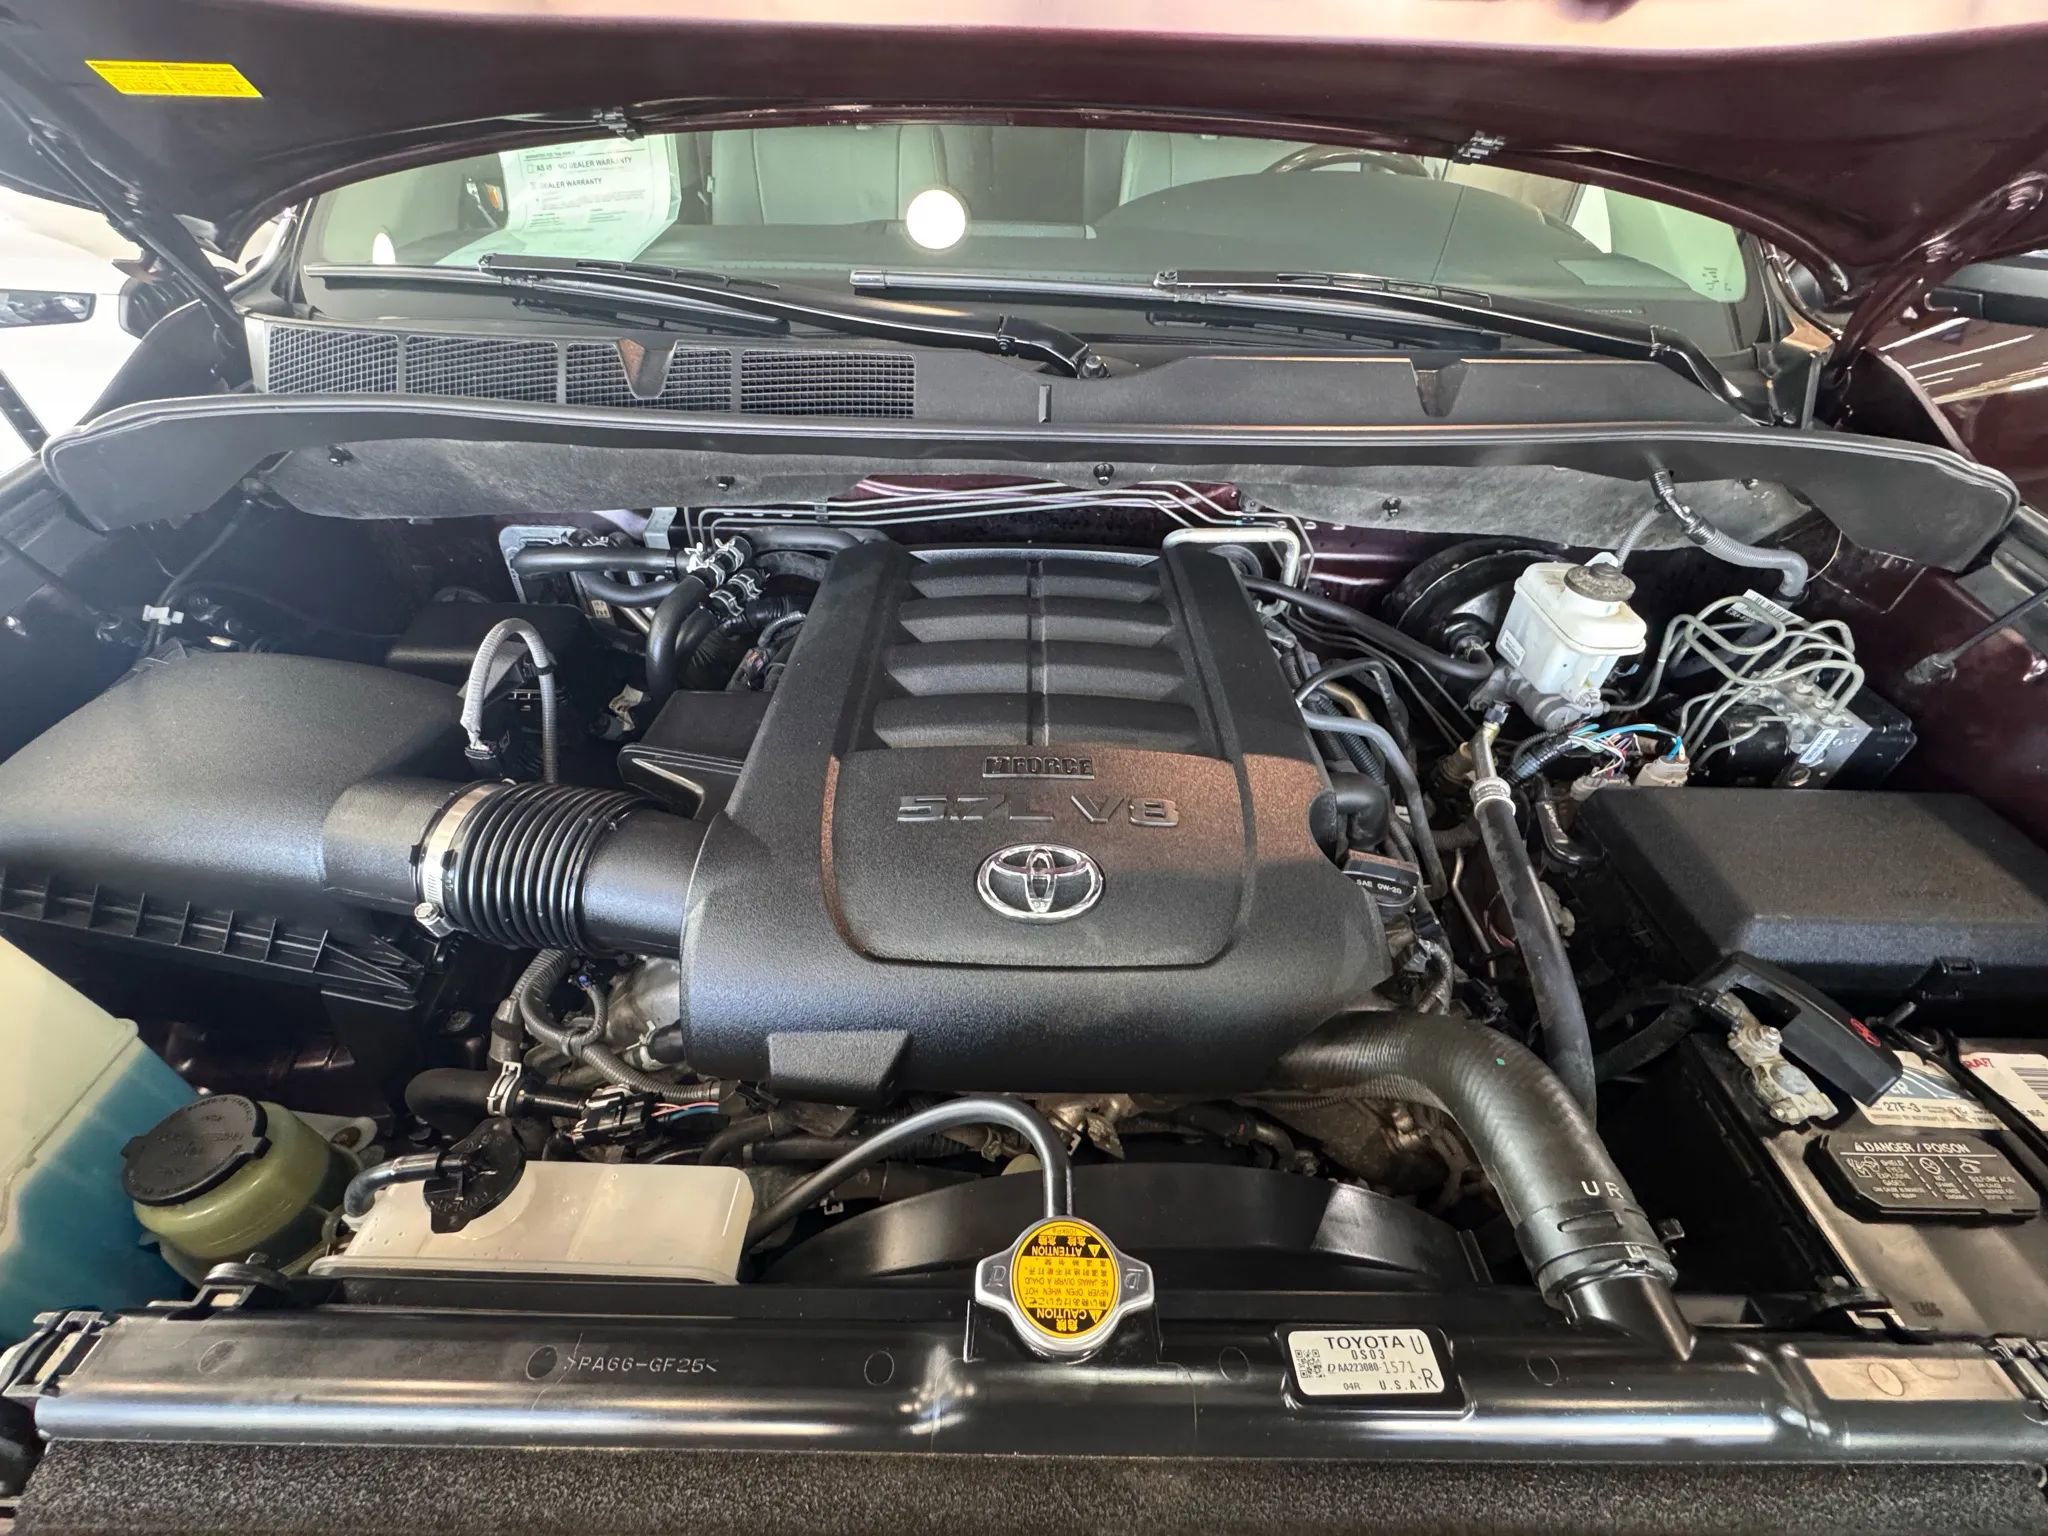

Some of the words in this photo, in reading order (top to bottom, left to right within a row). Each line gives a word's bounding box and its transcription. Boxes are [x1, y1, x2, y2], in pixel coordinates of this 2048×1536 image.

[1070, 795, 1180, 827] V8
[1356, 878, 1373, 888] SAE
[1377, 882, 1402, 895] 0W-20
[1882, 1100, 1921, 1113] 27F-3
[1862, 1141, 1914, 1153] DANGER
[1925, 1142, 1972, 1155] POISON
[1031, 1245, 1082, 1256] ATTENTION
[1042, 1287, 1062, 1295] WHEN
[1065, 1287, 1084, 1296] OPEN
[1087, 1288, 1109, 1297] NEVER
[1036, 1308, 1087, 1319] CAUTION
[1324, 1335, 1405, 1350] TOYOTA
[1409, 1335, 1425, 1355] U
[1421, 1368, 1439, 1389] R
[1343, 1382, 1361, 1391] 04R
